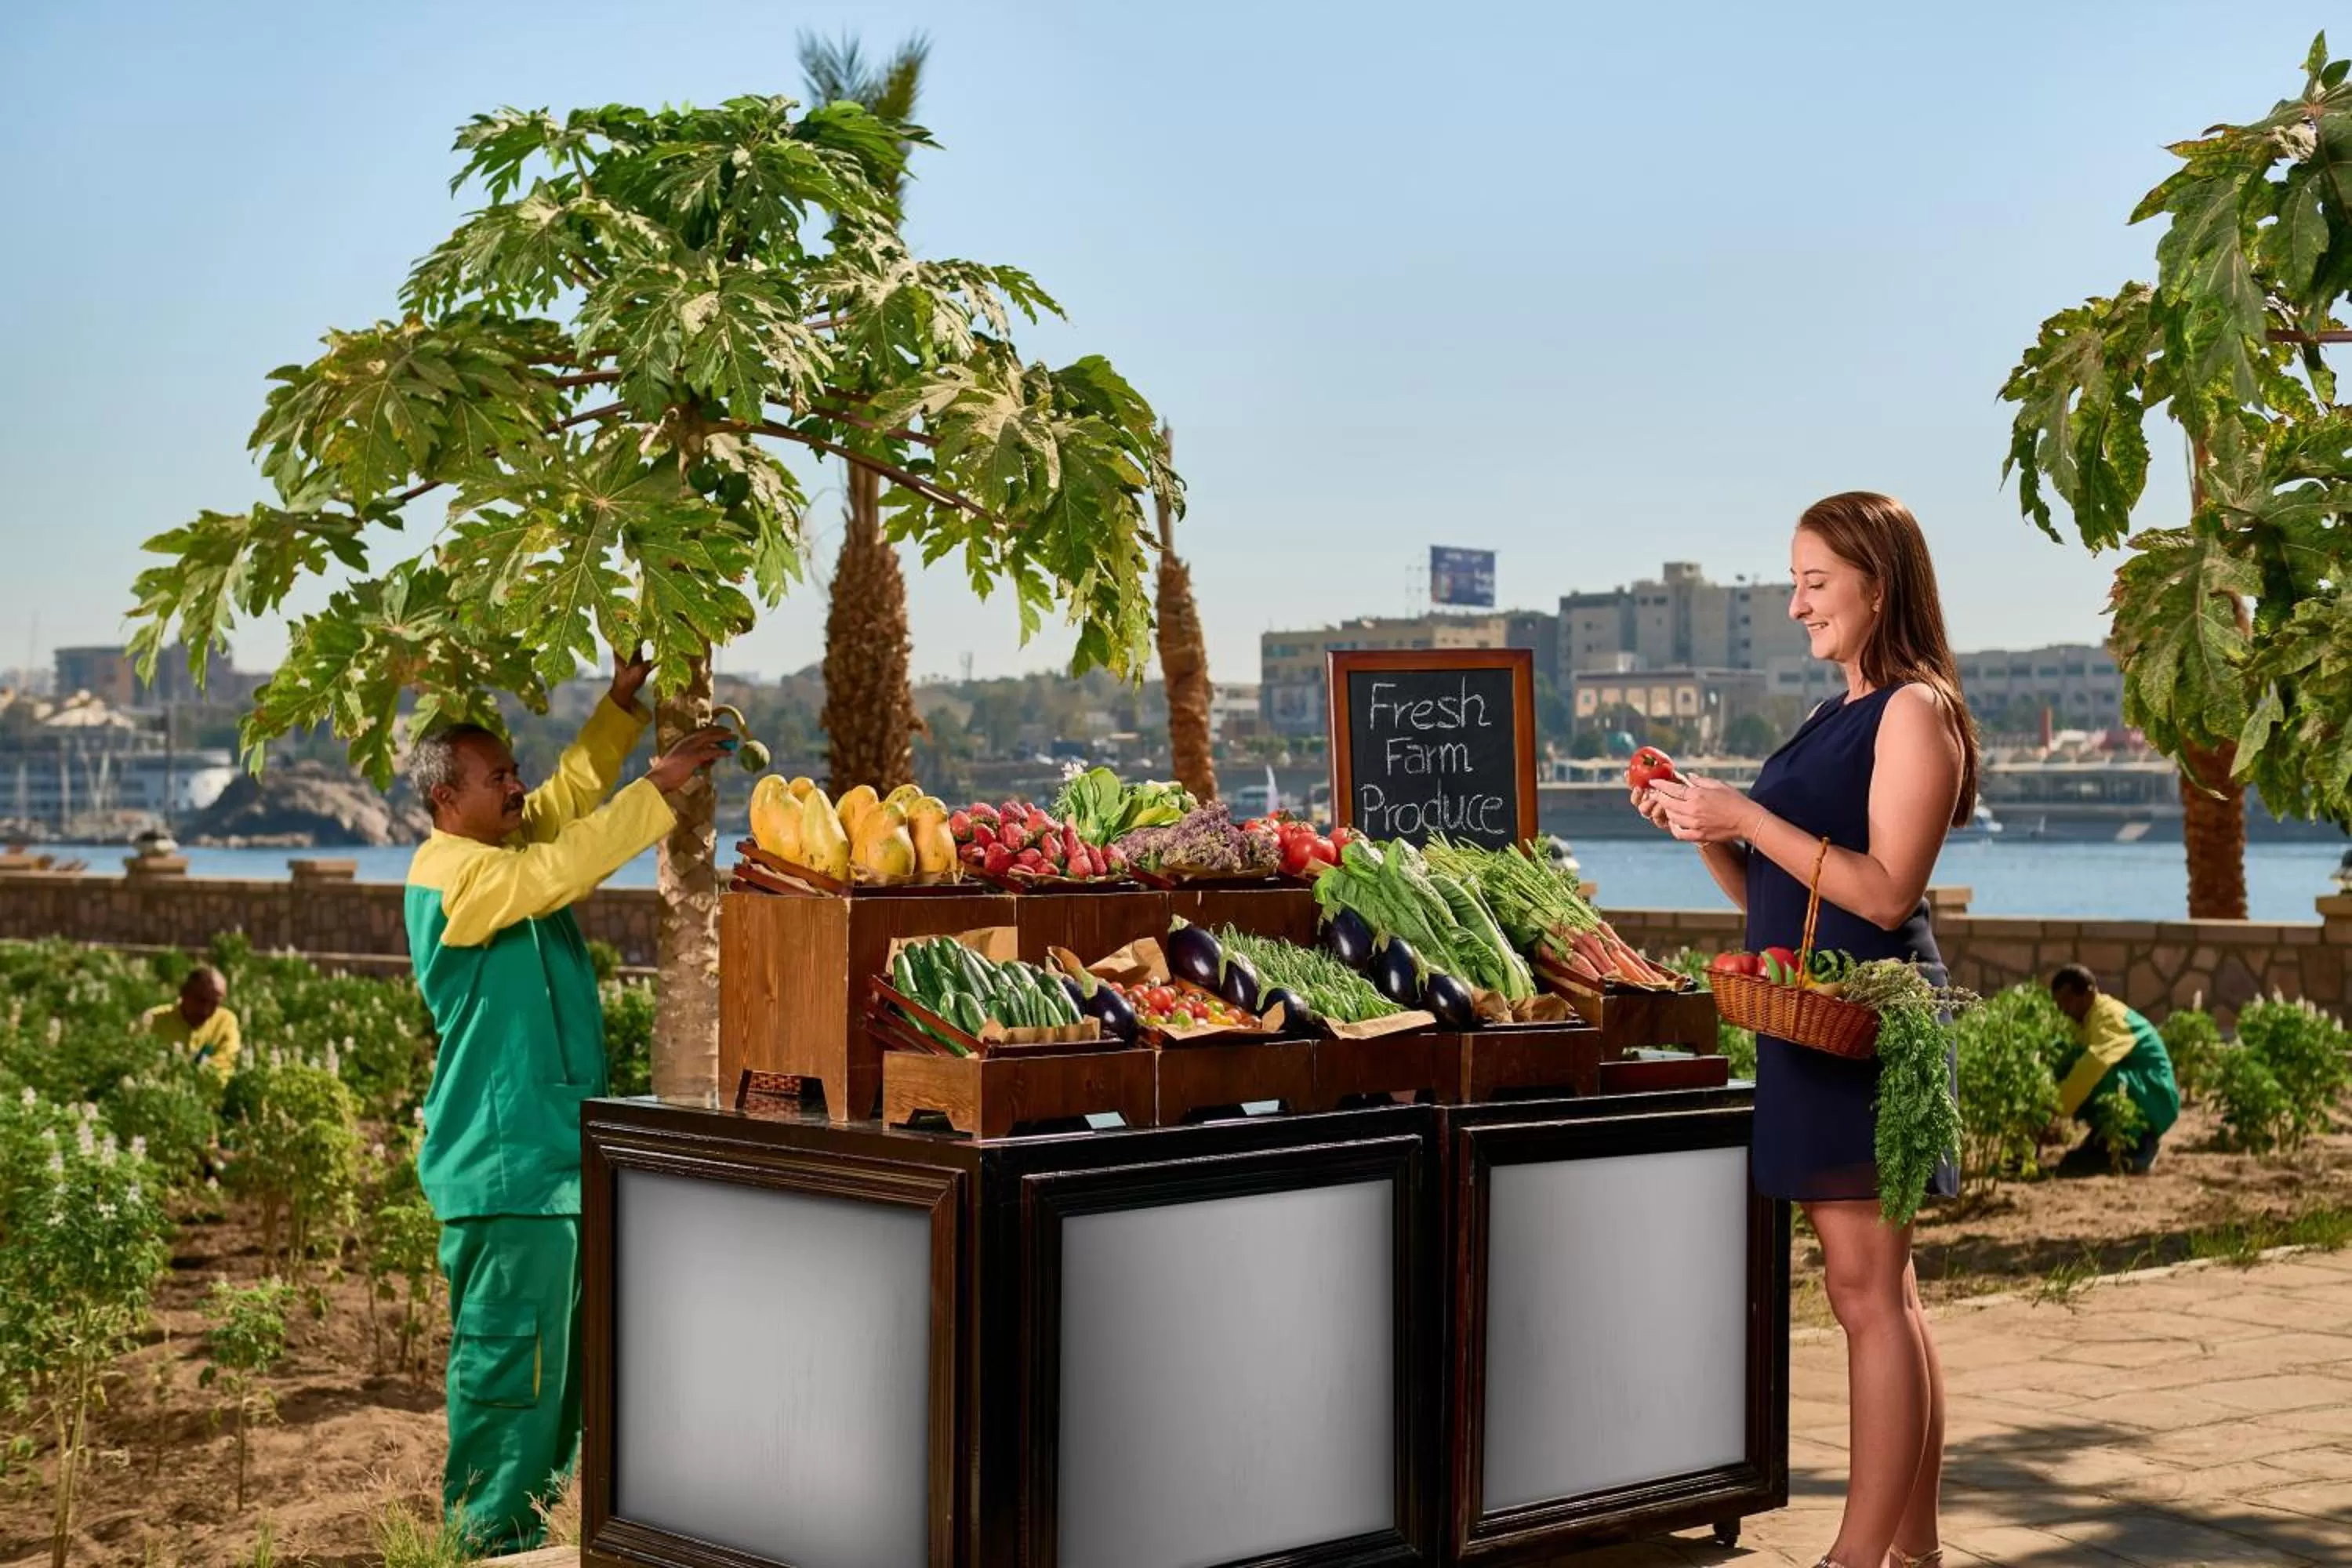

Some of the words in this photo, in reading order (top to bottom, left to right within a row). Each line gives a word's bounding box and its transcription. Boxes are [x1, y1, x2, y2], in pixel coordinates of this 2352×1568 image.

[1370, 675, 1491, 730] Fresh
[1386, 736, 1473, 776] Farm
[1360, 778, 1505, 834] Produce
